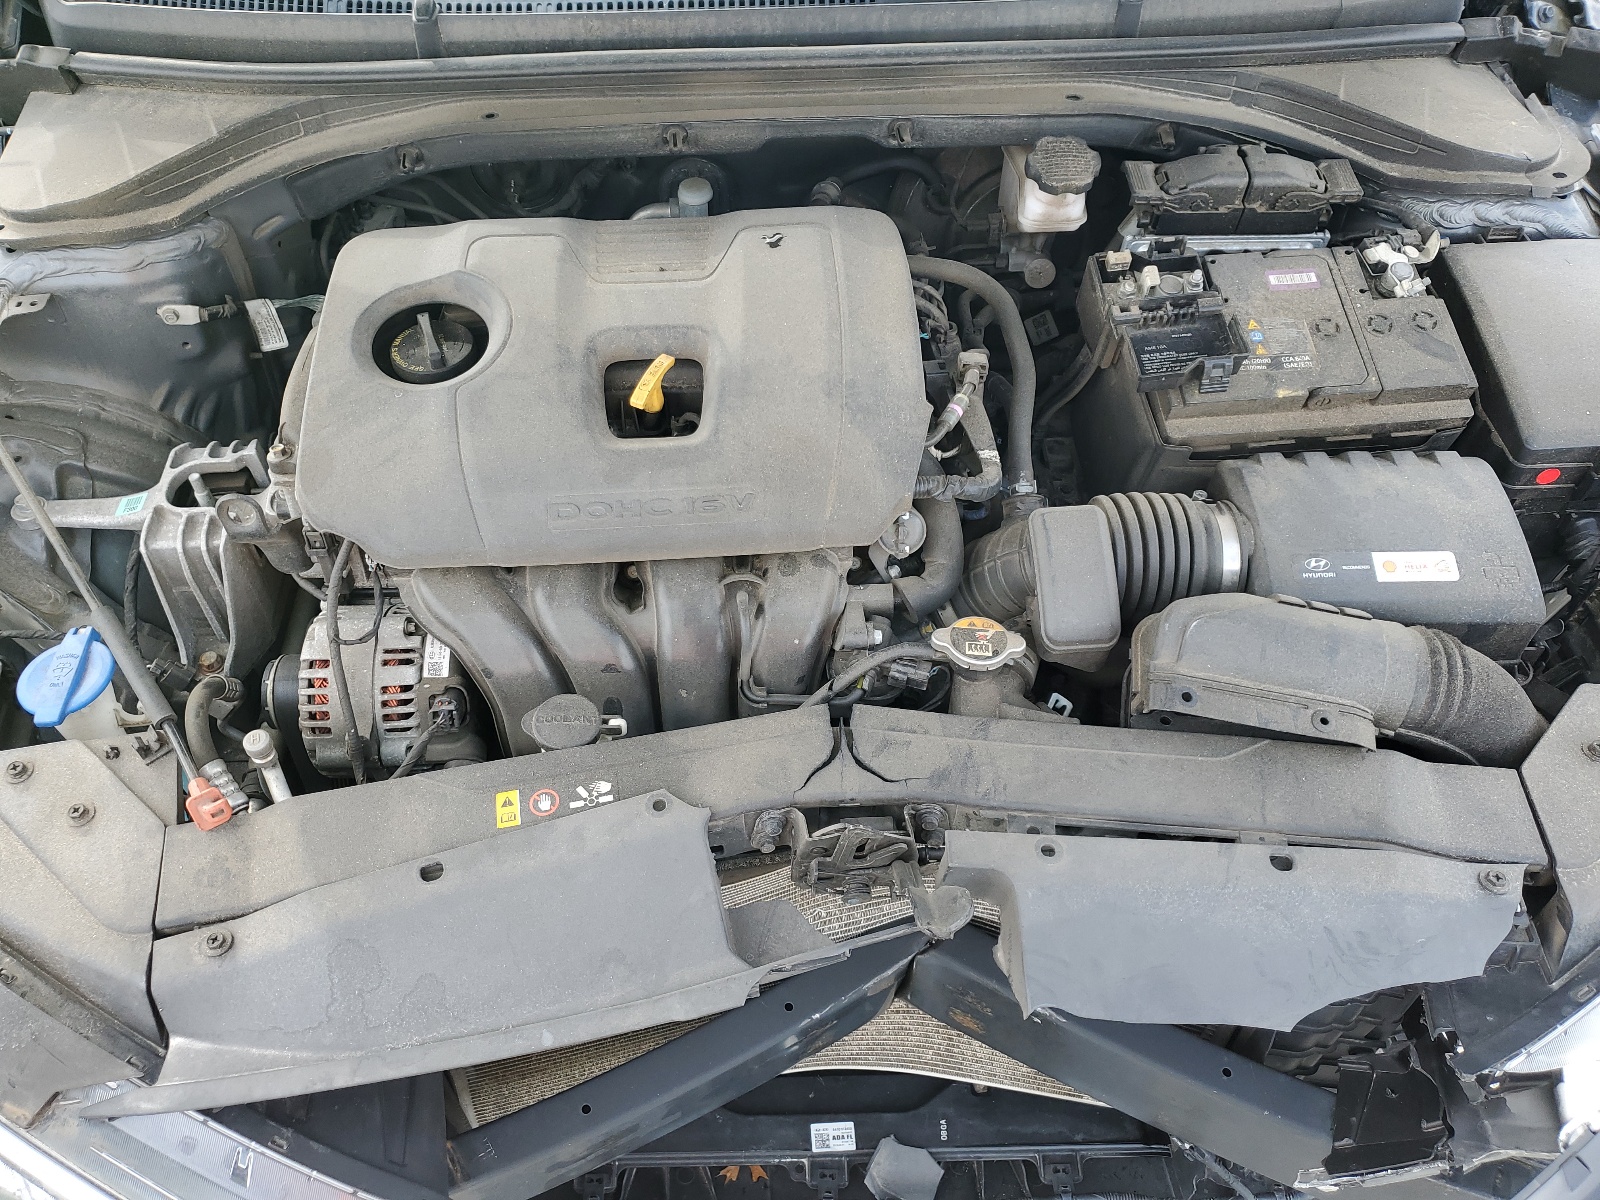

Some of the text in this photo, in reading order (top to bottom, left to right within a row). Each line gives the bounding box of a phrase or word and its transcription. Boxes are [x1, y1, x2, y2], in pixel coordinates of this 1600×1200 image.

[549, 492, 756, 521] DOHC 16V
[535, 714, 597, 726] COOLANT
